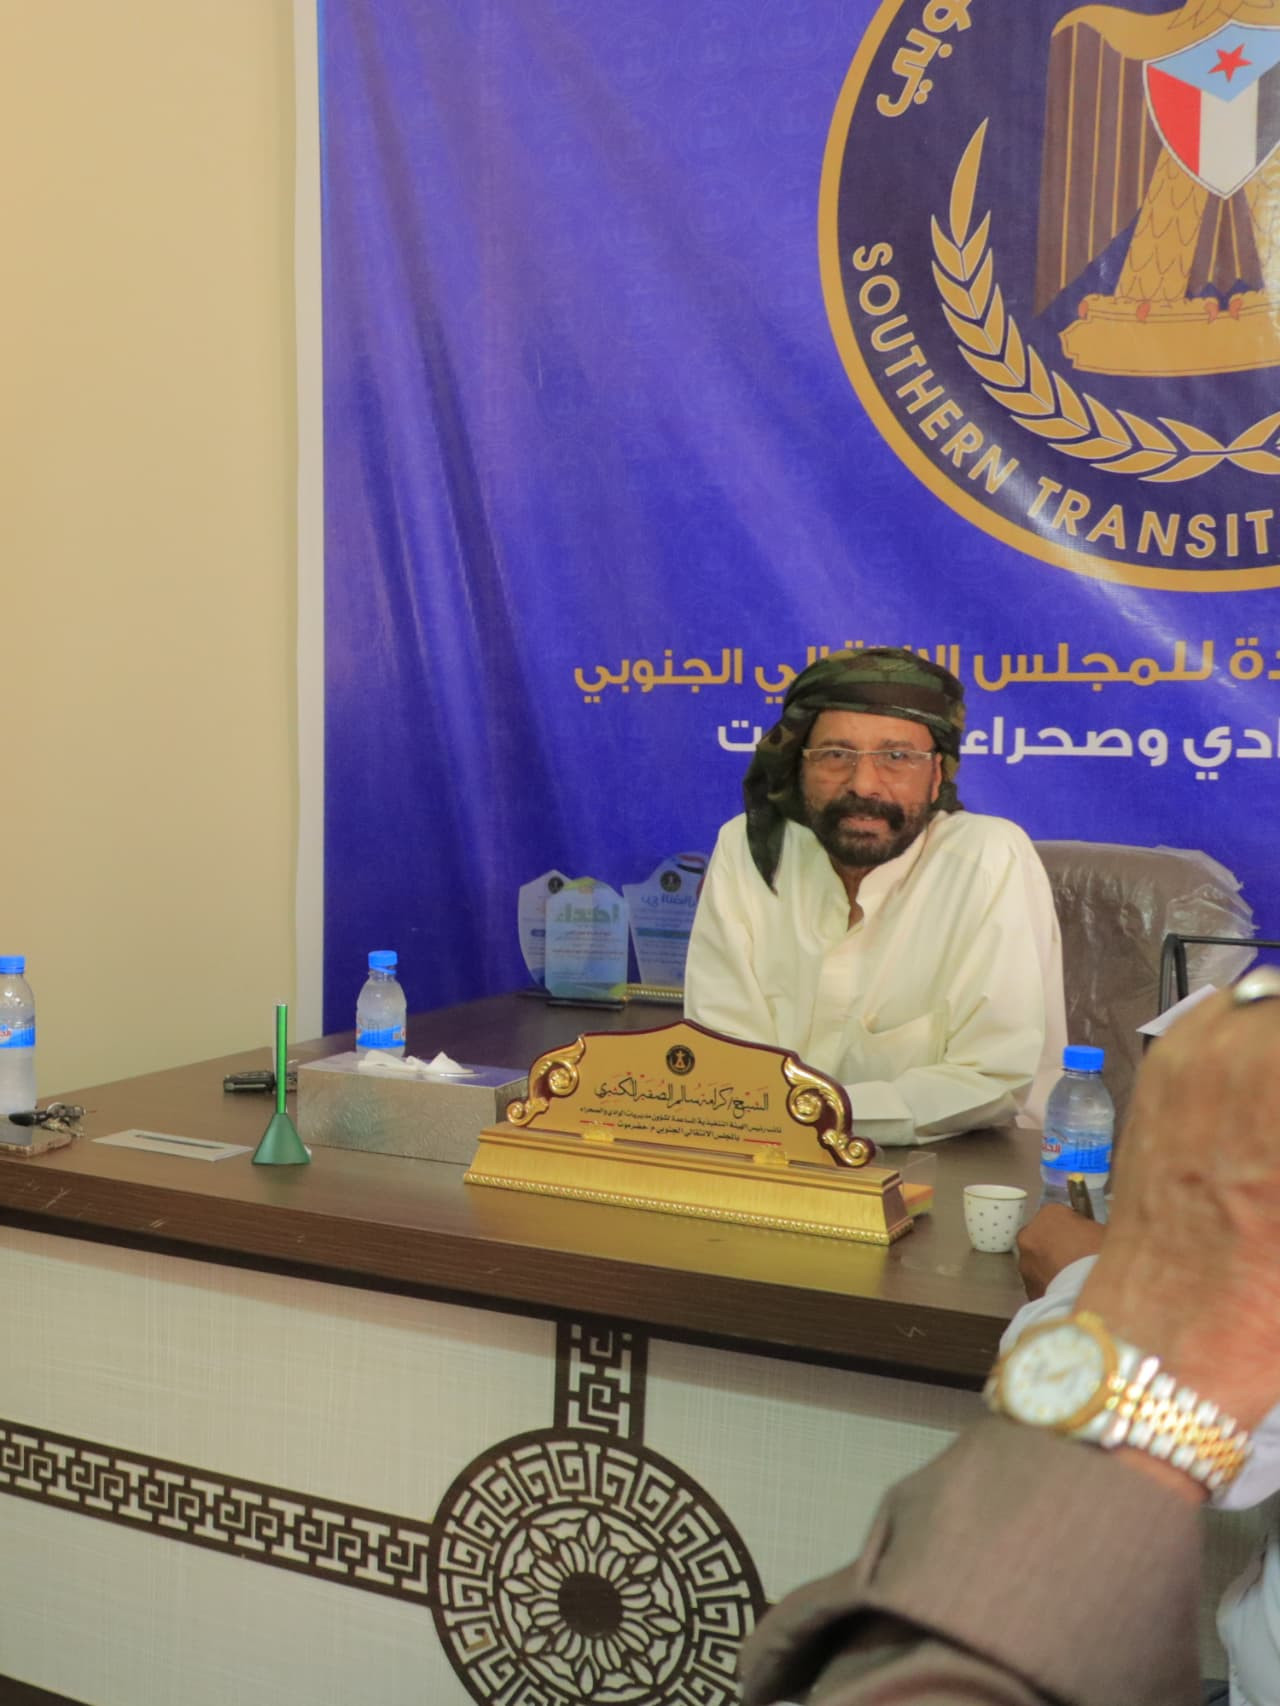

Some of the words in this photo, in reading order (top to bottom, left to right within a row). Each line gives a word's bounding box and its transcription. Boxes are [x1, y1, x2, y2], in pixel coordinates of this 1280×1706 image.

[852, 242, 1019, 495] SOUTHERN
[1026, 476, 1274, 558] TRANSIT
[574, 648, 743, 703] الجنوبي
[973, 640, 1214, 691] للمجلس
[959, 716, 1168, 766] وصحراء
